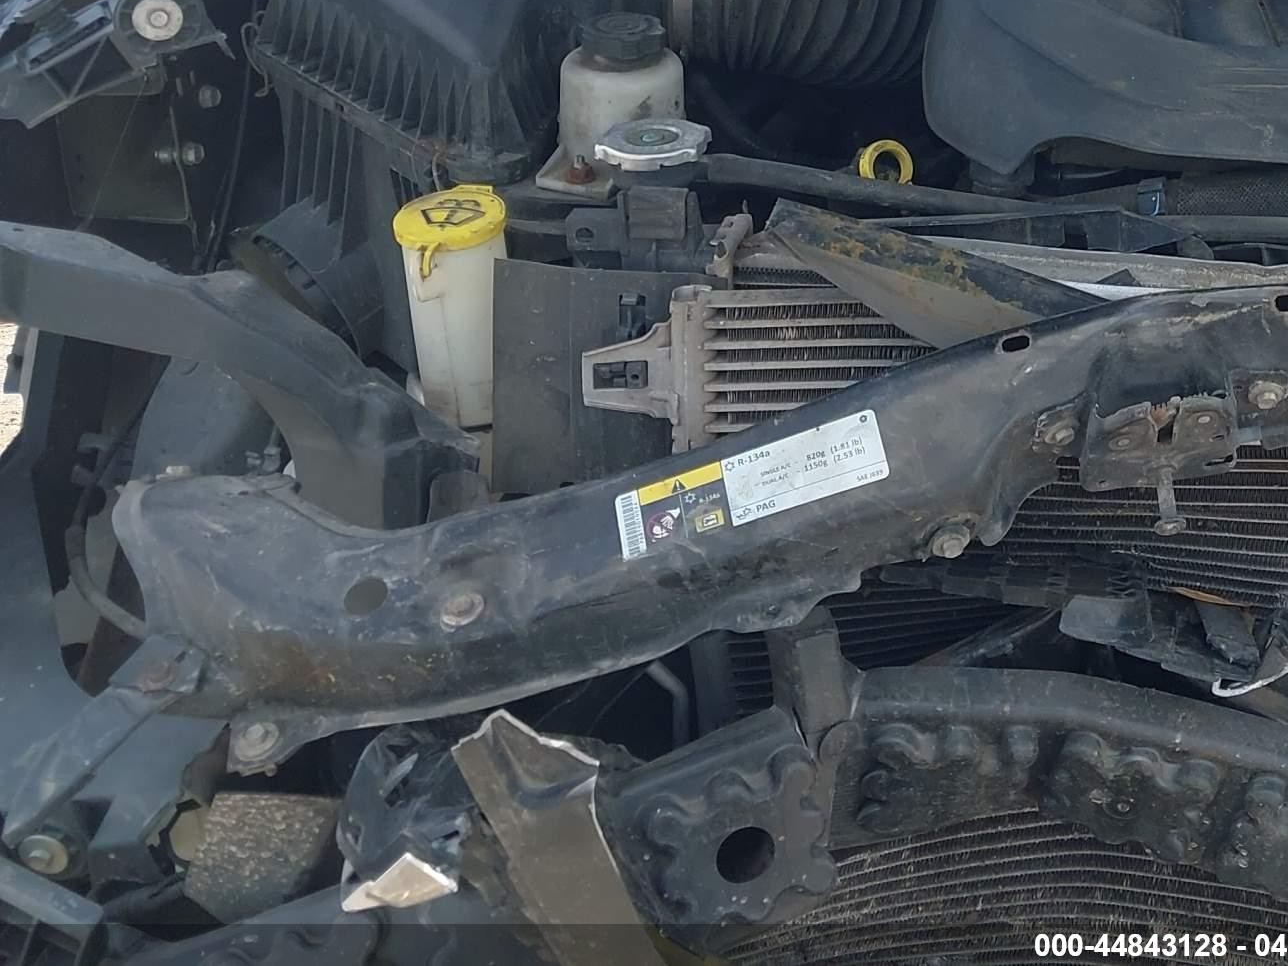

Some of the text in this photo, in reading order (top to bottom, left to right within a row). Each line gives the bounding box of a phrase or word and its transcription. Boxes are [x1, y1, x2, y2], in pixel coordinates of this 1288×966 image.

[737, 450, 770, 466] R-134a
[804, 460, 828, 472] 1150g
[833, 450, 853, 464] (2.53
[854, 445, 866, 457] lb)
[806, 451, 826, 461] 820g
[830, 441, 850, 455] (1.81
[851, 435, 863, 447] lb)
[756, 499, 776, 513] PAG
